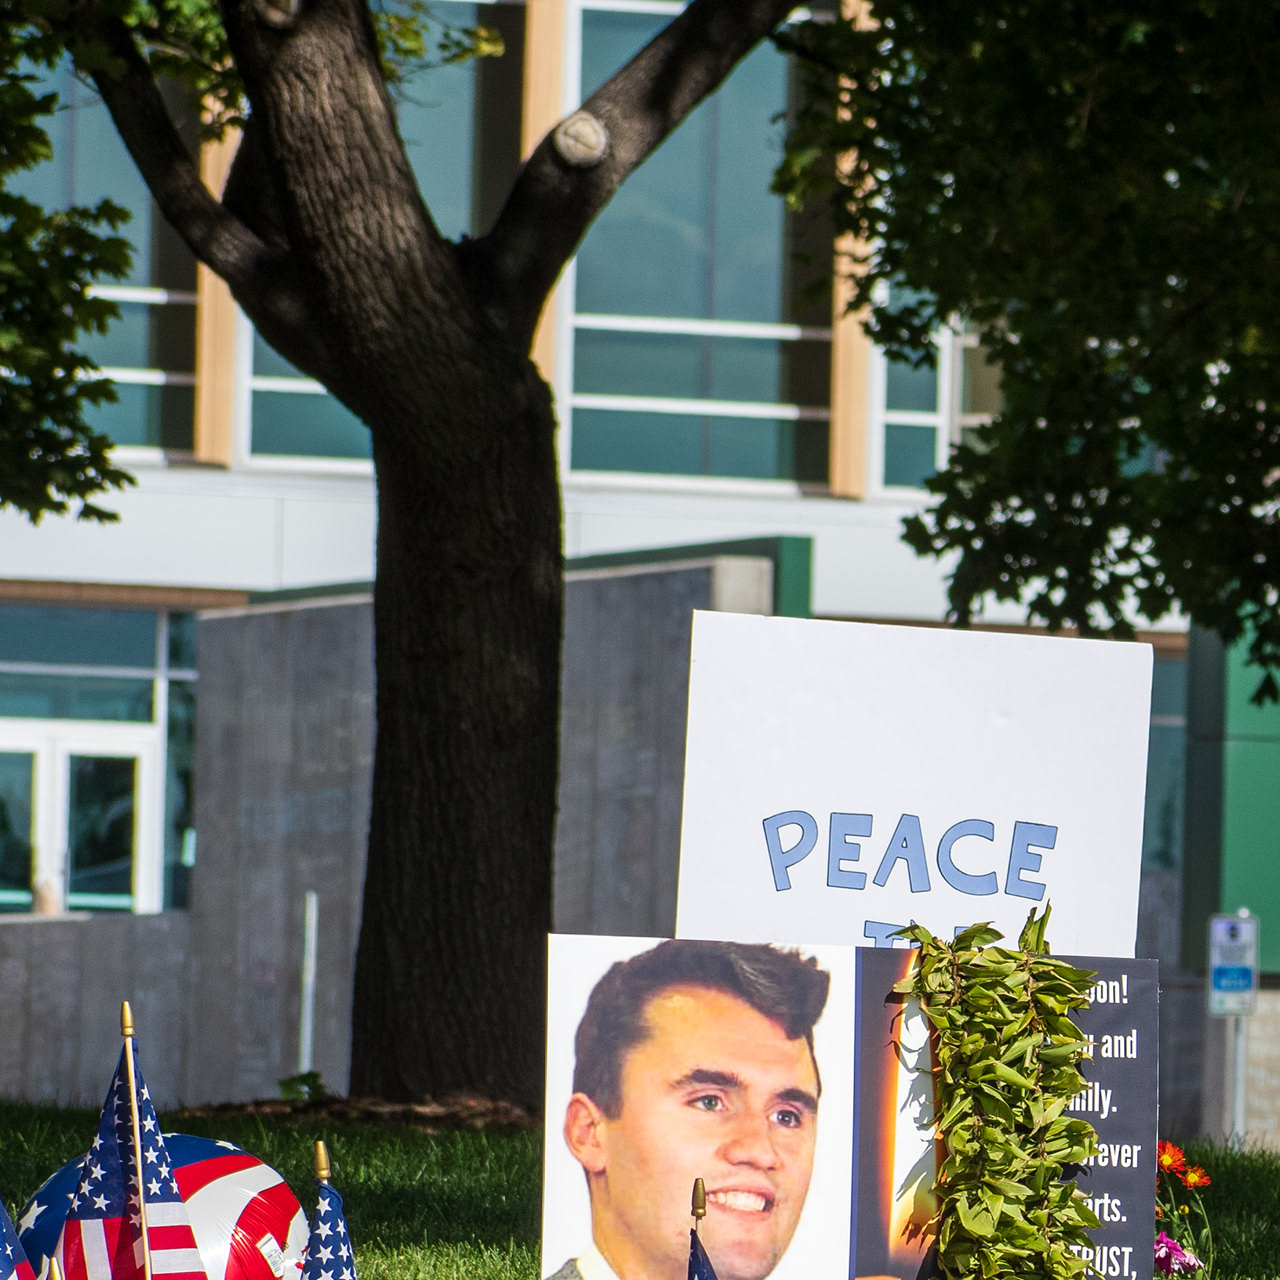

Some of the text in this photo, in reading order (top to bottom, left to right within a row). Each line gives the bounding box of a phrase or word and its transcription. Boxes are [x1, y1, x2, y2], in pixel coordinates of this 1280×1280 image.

[762, 810, 1058, 901] PEACE
[1101, 1028, 1138, 1059] and
[1069, 1082, 1118, 1119] mily.
